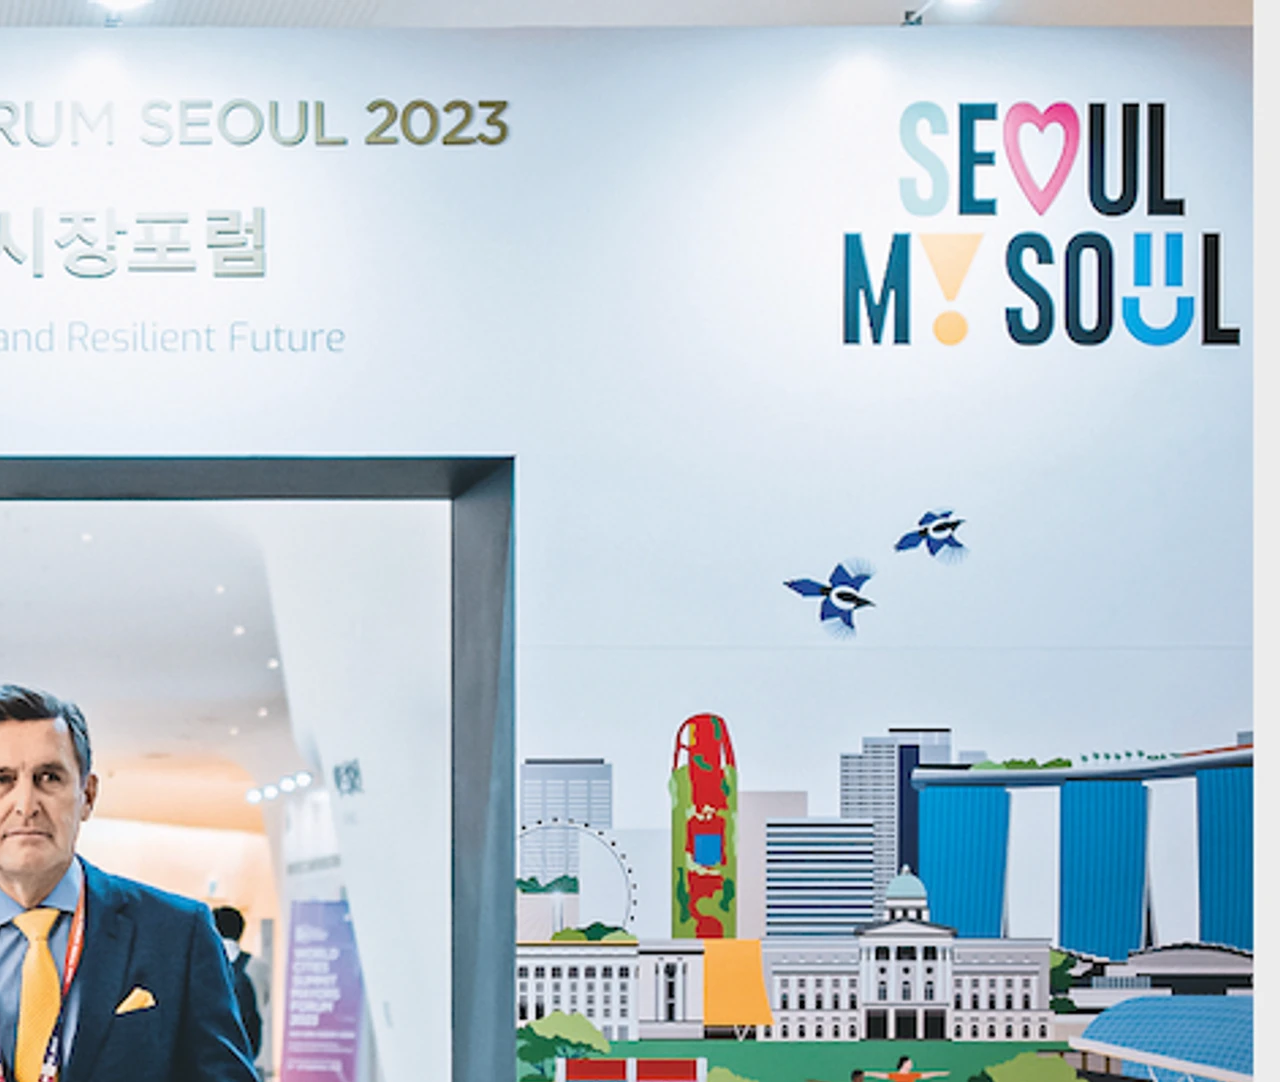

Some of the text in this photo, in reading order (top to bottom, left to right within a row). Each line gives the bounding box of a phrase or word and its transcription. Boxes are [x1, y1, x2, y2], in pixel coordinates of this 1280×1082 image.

[140, 98, 349, 147] SEOUL
[364, 98, 511, 147] 2023
[67, 321, 217, 353] Resilient
[228, 321, 346, 353] Future
